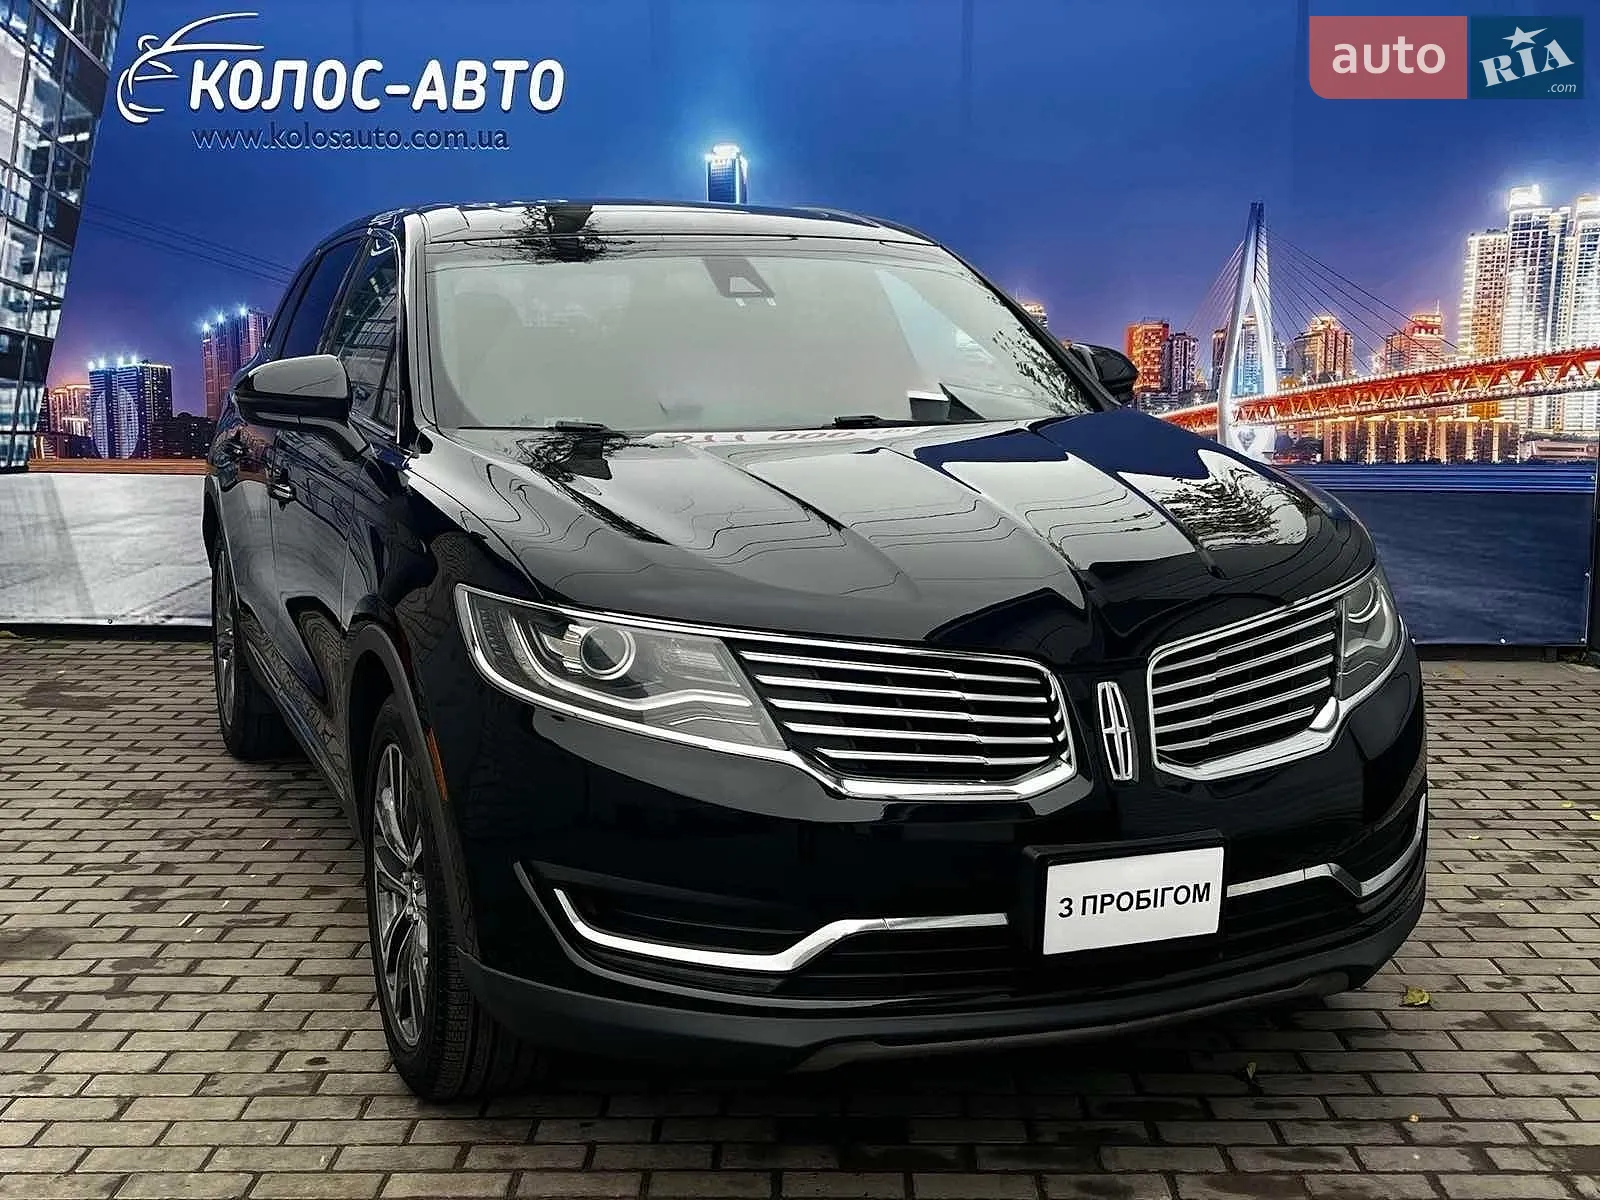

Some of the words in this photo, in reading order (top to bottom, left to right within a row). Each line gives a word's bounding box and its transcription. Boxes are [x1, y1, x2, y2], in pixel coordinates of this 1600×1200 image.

[190, 59, 565, 112] КОЛОС-АВТО
[192, 122, 510, 151] www.kolosauto.com.ua
[1081, 882, 1211, 916] ПРОБІГОМ
